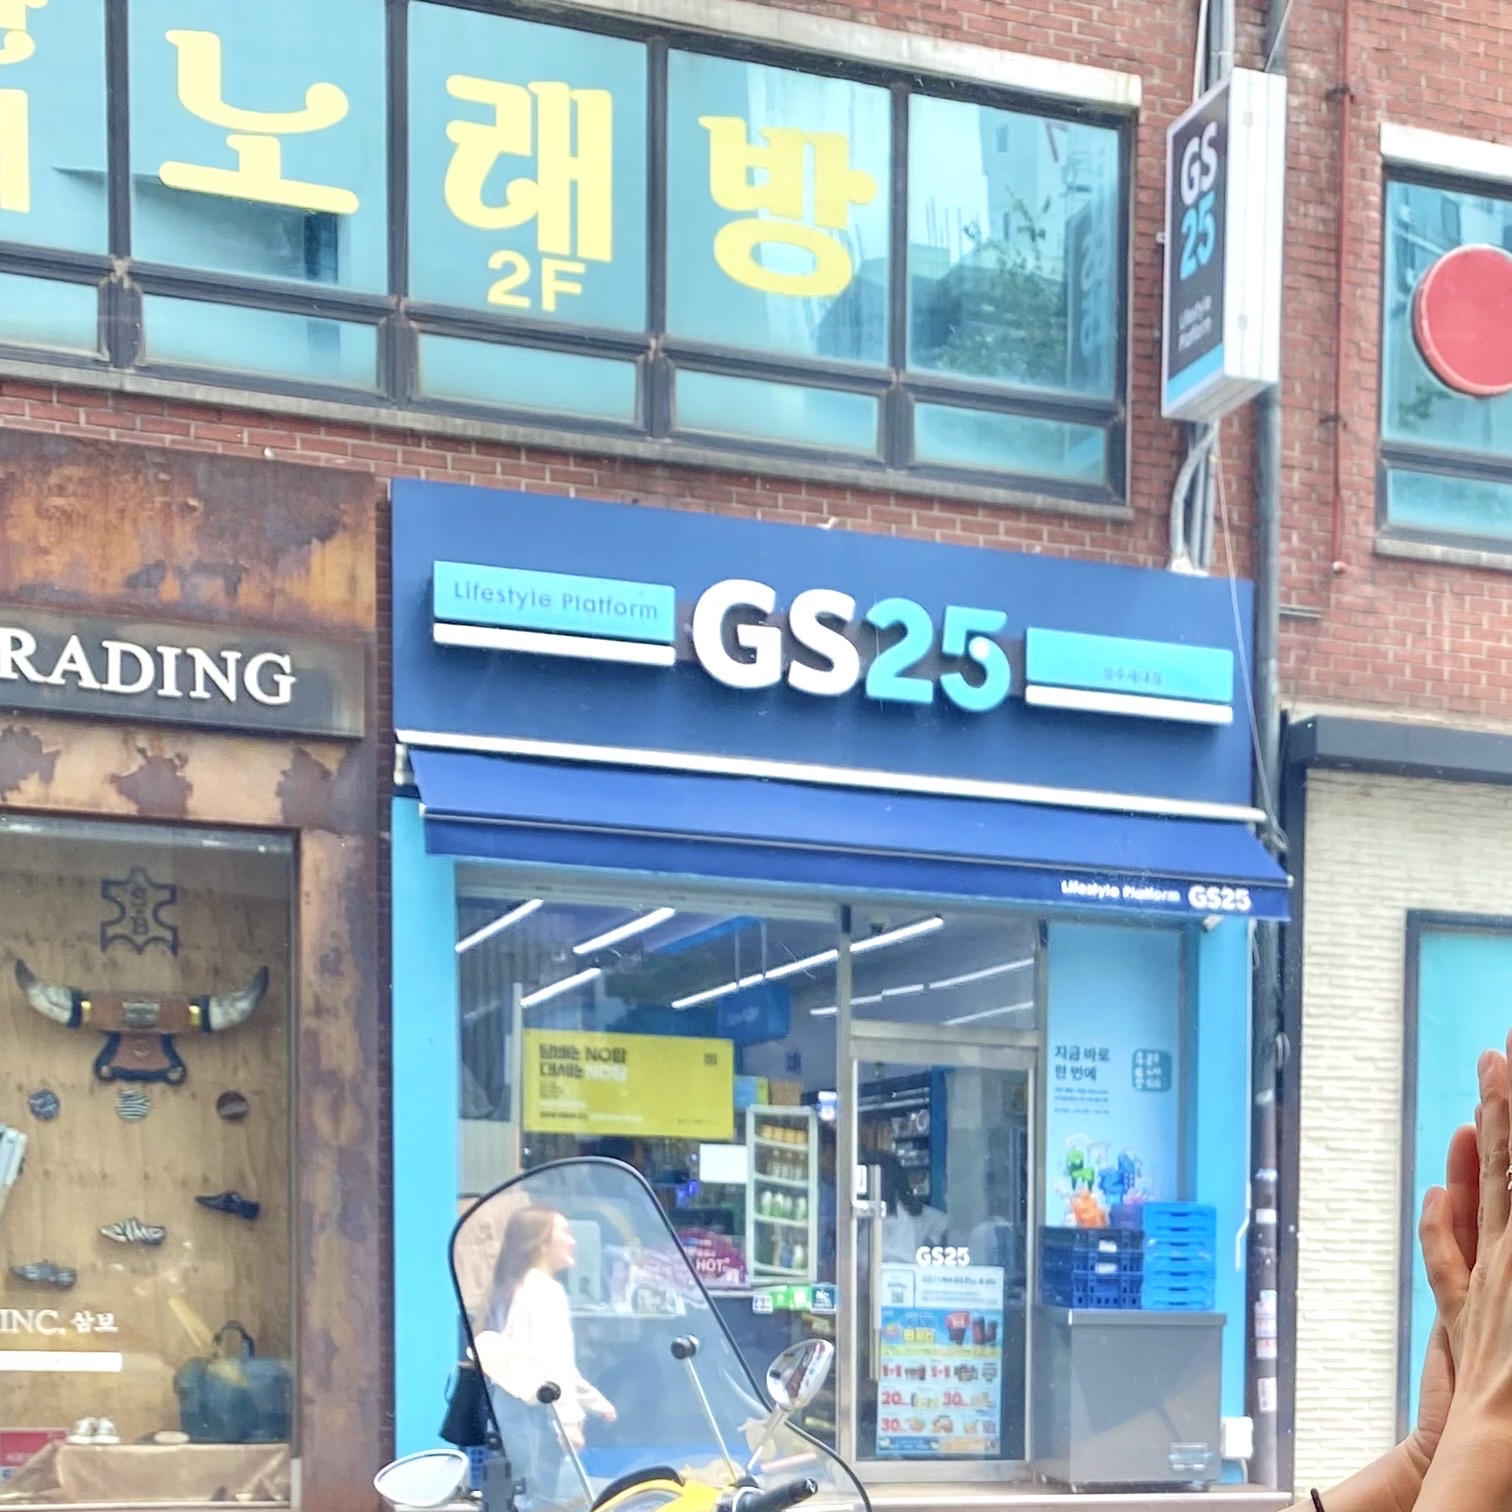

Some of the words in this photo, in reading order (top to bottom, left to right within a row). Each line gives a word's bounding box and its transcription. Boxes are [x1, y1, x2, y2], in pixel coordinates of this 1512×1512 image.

[158, 30, 879, 297] 노래방
[1180, 121, 1218, 206] GS
[1179, 190, 1217, 281] 25
[487, 250, 586, 311] 2F
[454, 581, 552, 611] Lifestyle
[562, 592, 658, 620] Platform
[693, 578, 1012, 712] GS25
[1187, 884, 1252, 912] GS25
[915, 1246, 971, 1266] GS25
